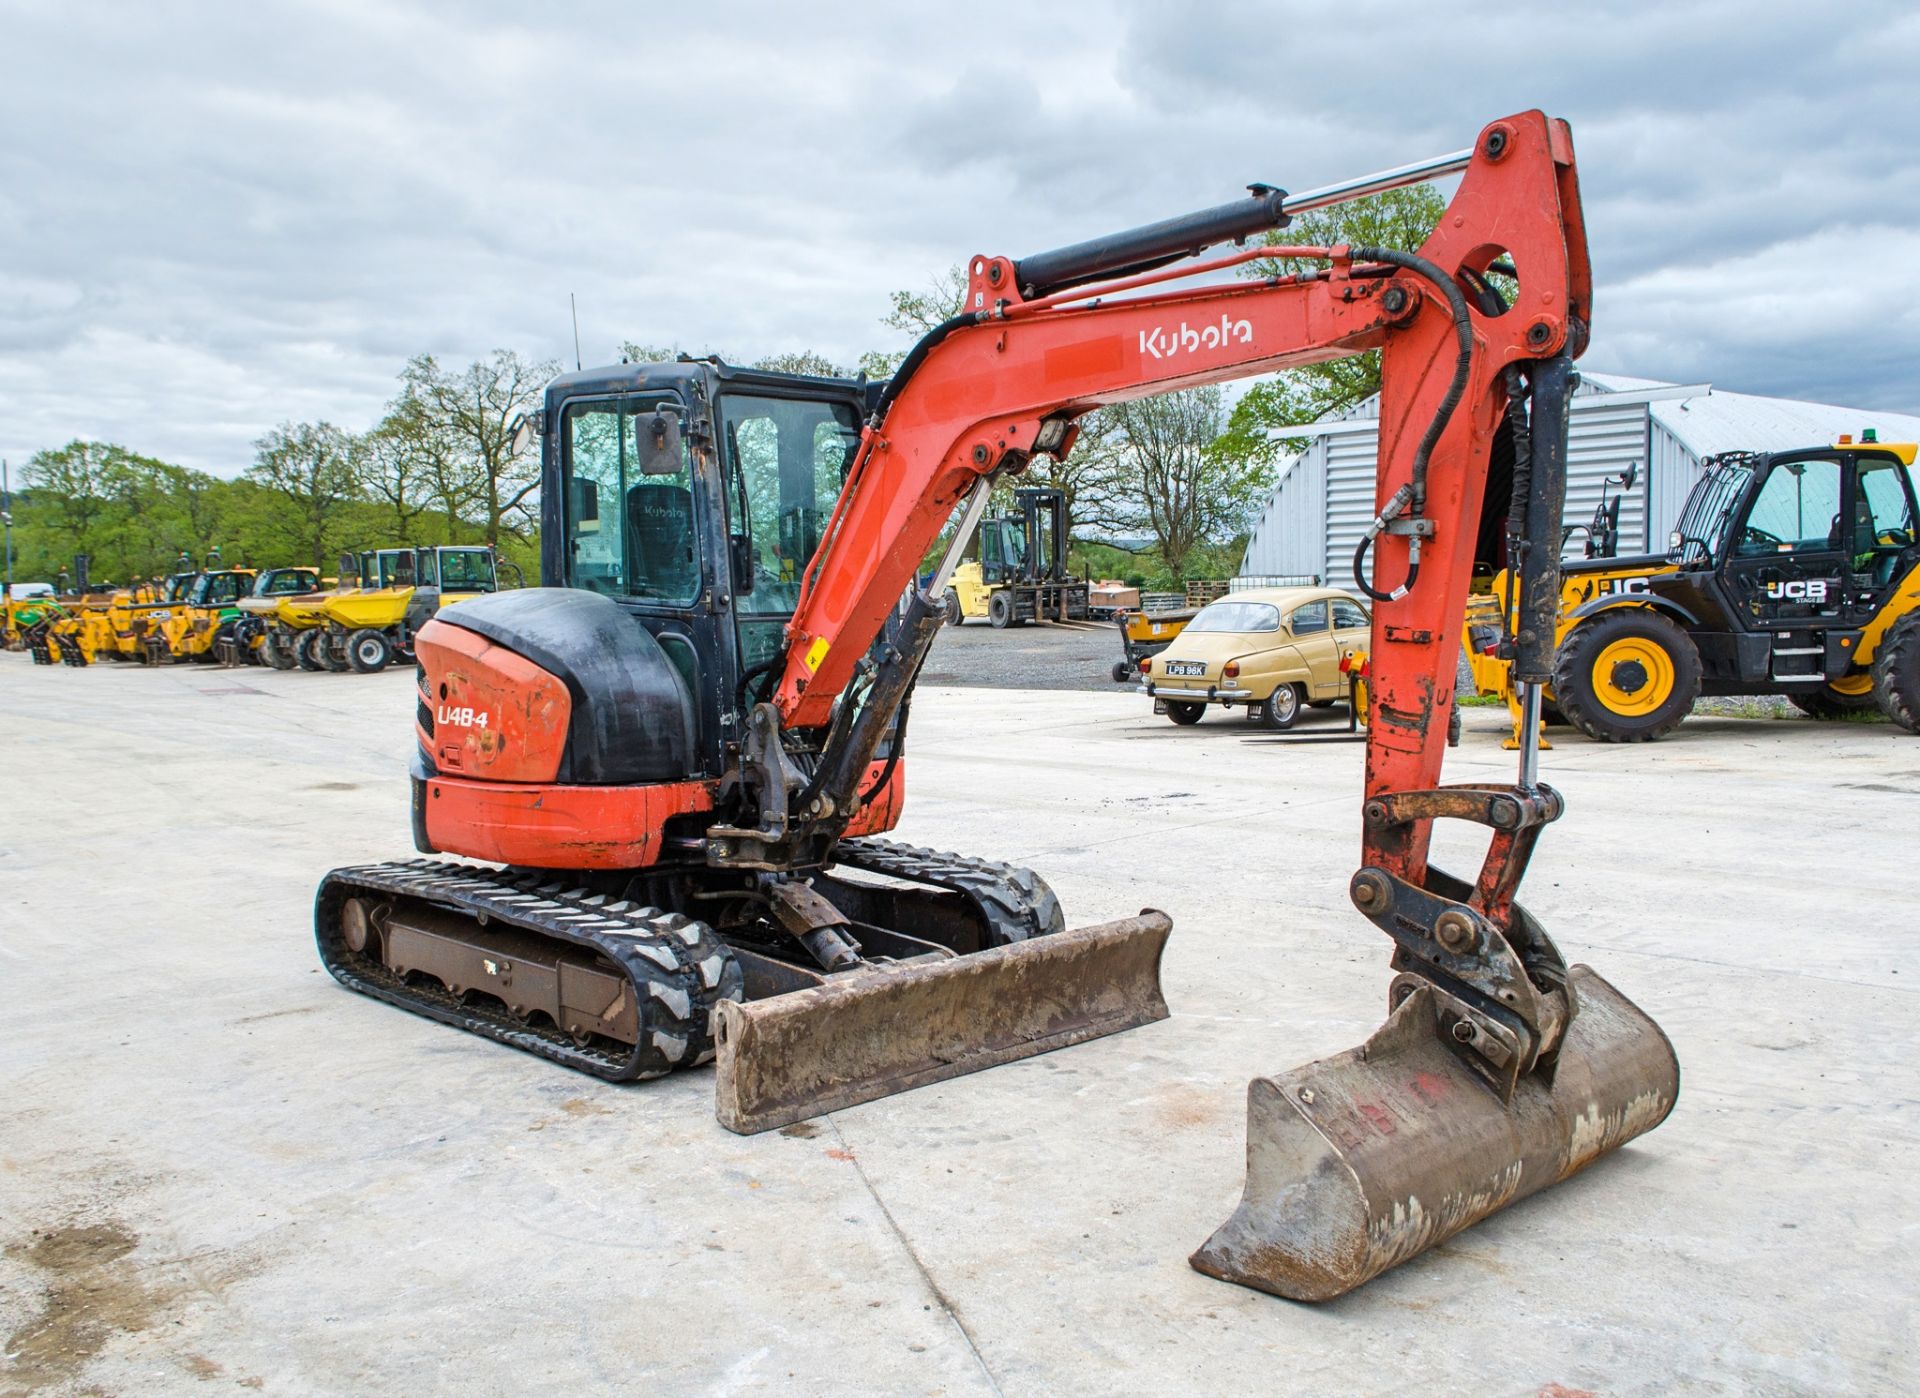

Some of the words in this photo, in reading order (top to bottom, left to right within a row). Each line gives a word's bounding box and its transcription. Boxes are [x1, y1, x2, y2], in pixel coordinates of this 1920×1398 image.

[1139, 314, 1253, 359] Kubota
[1600, 577, 1651, 596] JC
[1767, 581, 1827, 599] JCB
[1168, 664, 1185, 675] LPB
[437, 705, 488, 728] U48-4
